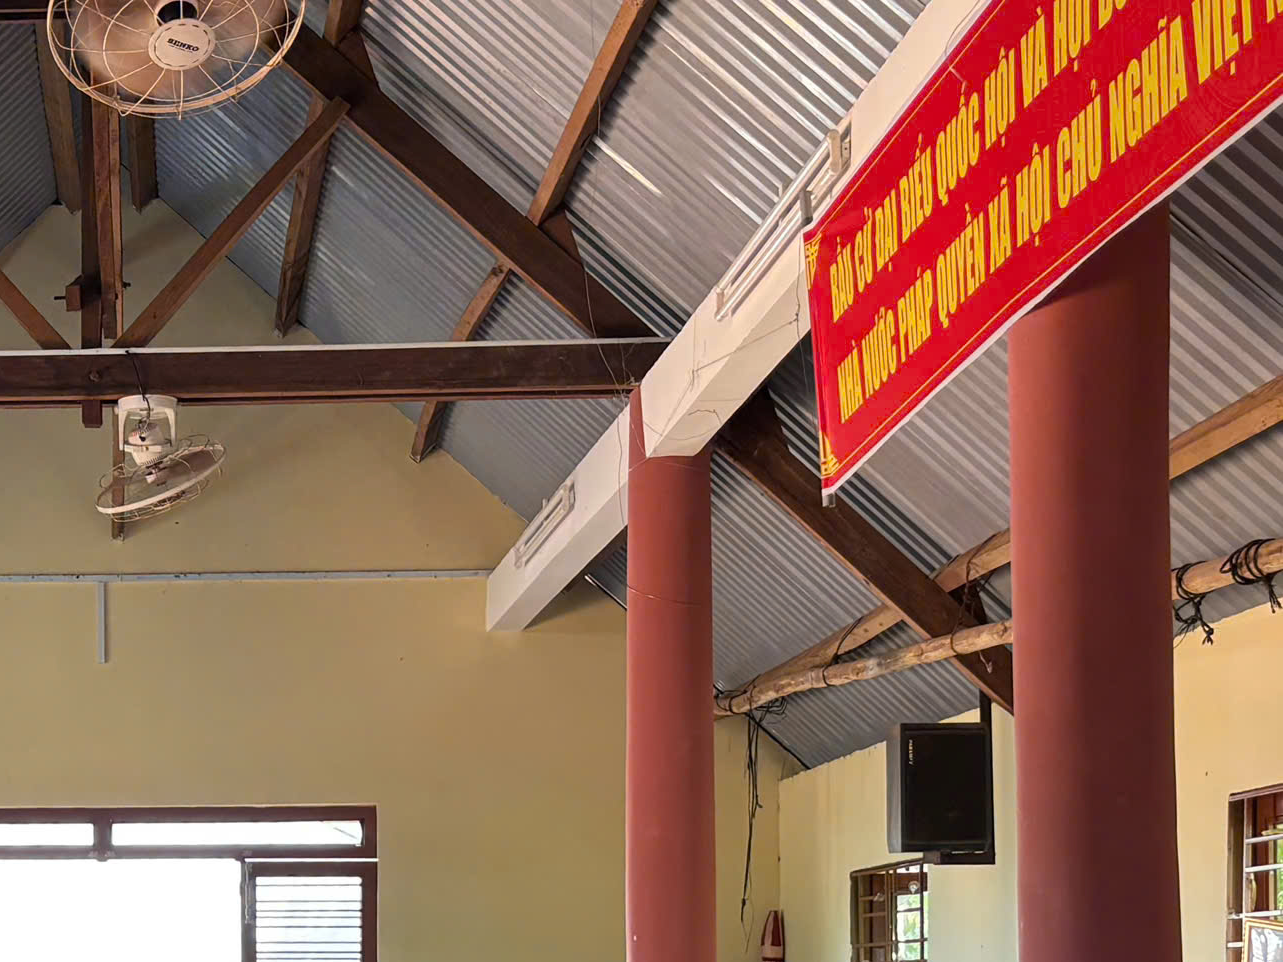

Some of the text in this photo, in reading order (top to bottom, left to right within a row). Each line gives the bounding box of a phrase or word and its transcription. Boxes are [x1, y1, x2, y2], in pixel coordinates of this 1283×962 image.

[829, 236, 854, 324] BẦU
[875, 188, 899, 273] ĐẠI
[899, 132, 933, 244] BIỂU
[935, 80, 981, 207] QUỐC
[984, 46, 1016, 150] HỘI
[1020, 6, 1049, 109] VÀ
[837, 339, 864, 425] NHÀ
[861, 306, 898, 400] NƯỚC
[898, 266, 934, 364] PHÁP
[935, 202, 986, 329] QUYỀN
[988, 175, 1012, 275] XÃ
[1015, 141, 1053, 248] HỘI
[1056, 79, 1103, 208] CHỦ
[1108, 16, 1189, 164] NGHĨA
